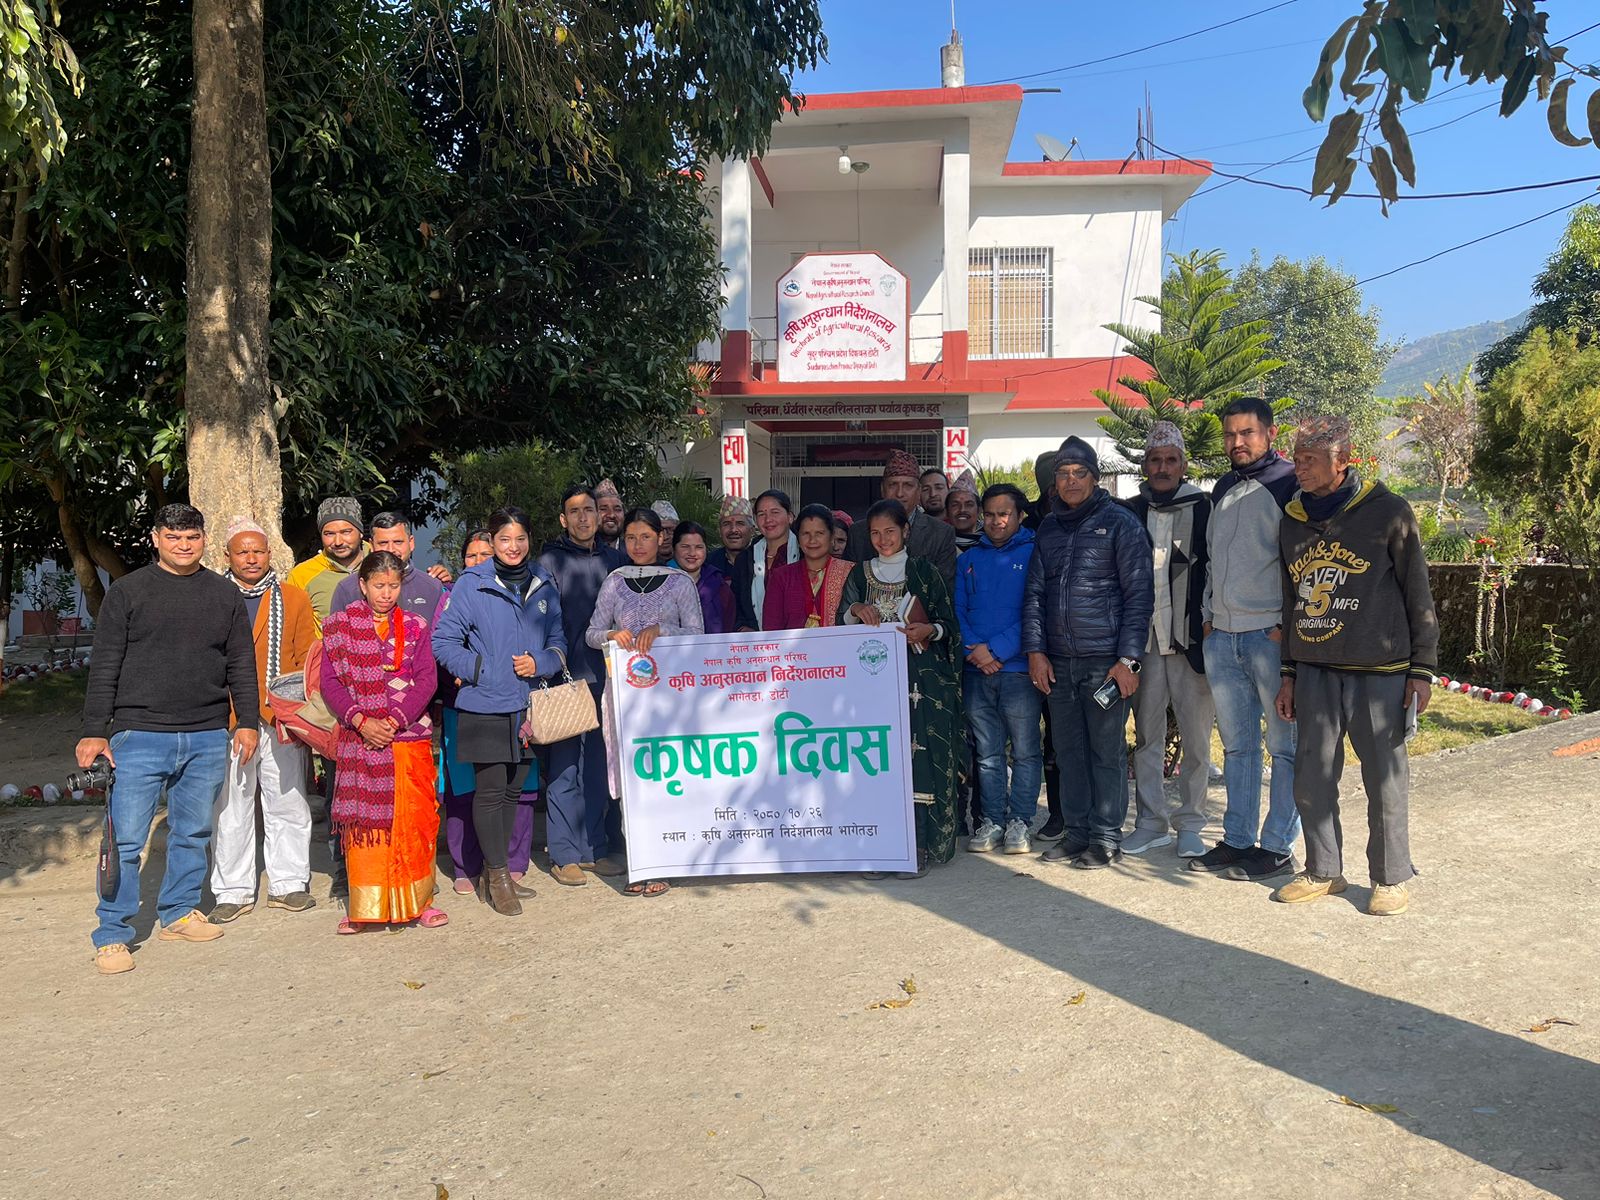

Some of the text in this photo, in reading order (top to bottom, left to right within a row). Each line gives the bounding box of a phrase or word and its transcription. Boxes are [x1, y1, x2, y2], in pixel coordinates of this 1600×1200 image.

[784, 301, 897, 344] कृषि अनुसन्धान निर्देशनालय
[1301, 567, 1348, 586] EVEN
[1332, 598, 1360, 611] MFG
[1298, 618, 1337, 629] ORIGINALS
[1315, 620, 1345, 643] COMPANY
[730, 643, 780, 653] नेपाल सरकार
[703, 651, 809, 668] नेपाल कृषि अनुसन्धान परिषद्
[668, 664, 847, 692] कृषि अनुसन्धान निर्देशनालय
[769, 687, 789, 701] डोटी
[632, 711, 892, 796] कृषक दिवस
[714, 806, 737, 821] मिति
[662, 831, 686, 843] स्थान
[701, 826, 721, 845] कृषि
[727, 828, 774, 844] अनुसन्धान
[779, 823, 833, 838] निर्देशनालय
[838, 822, 878, 837] भागेतडा
